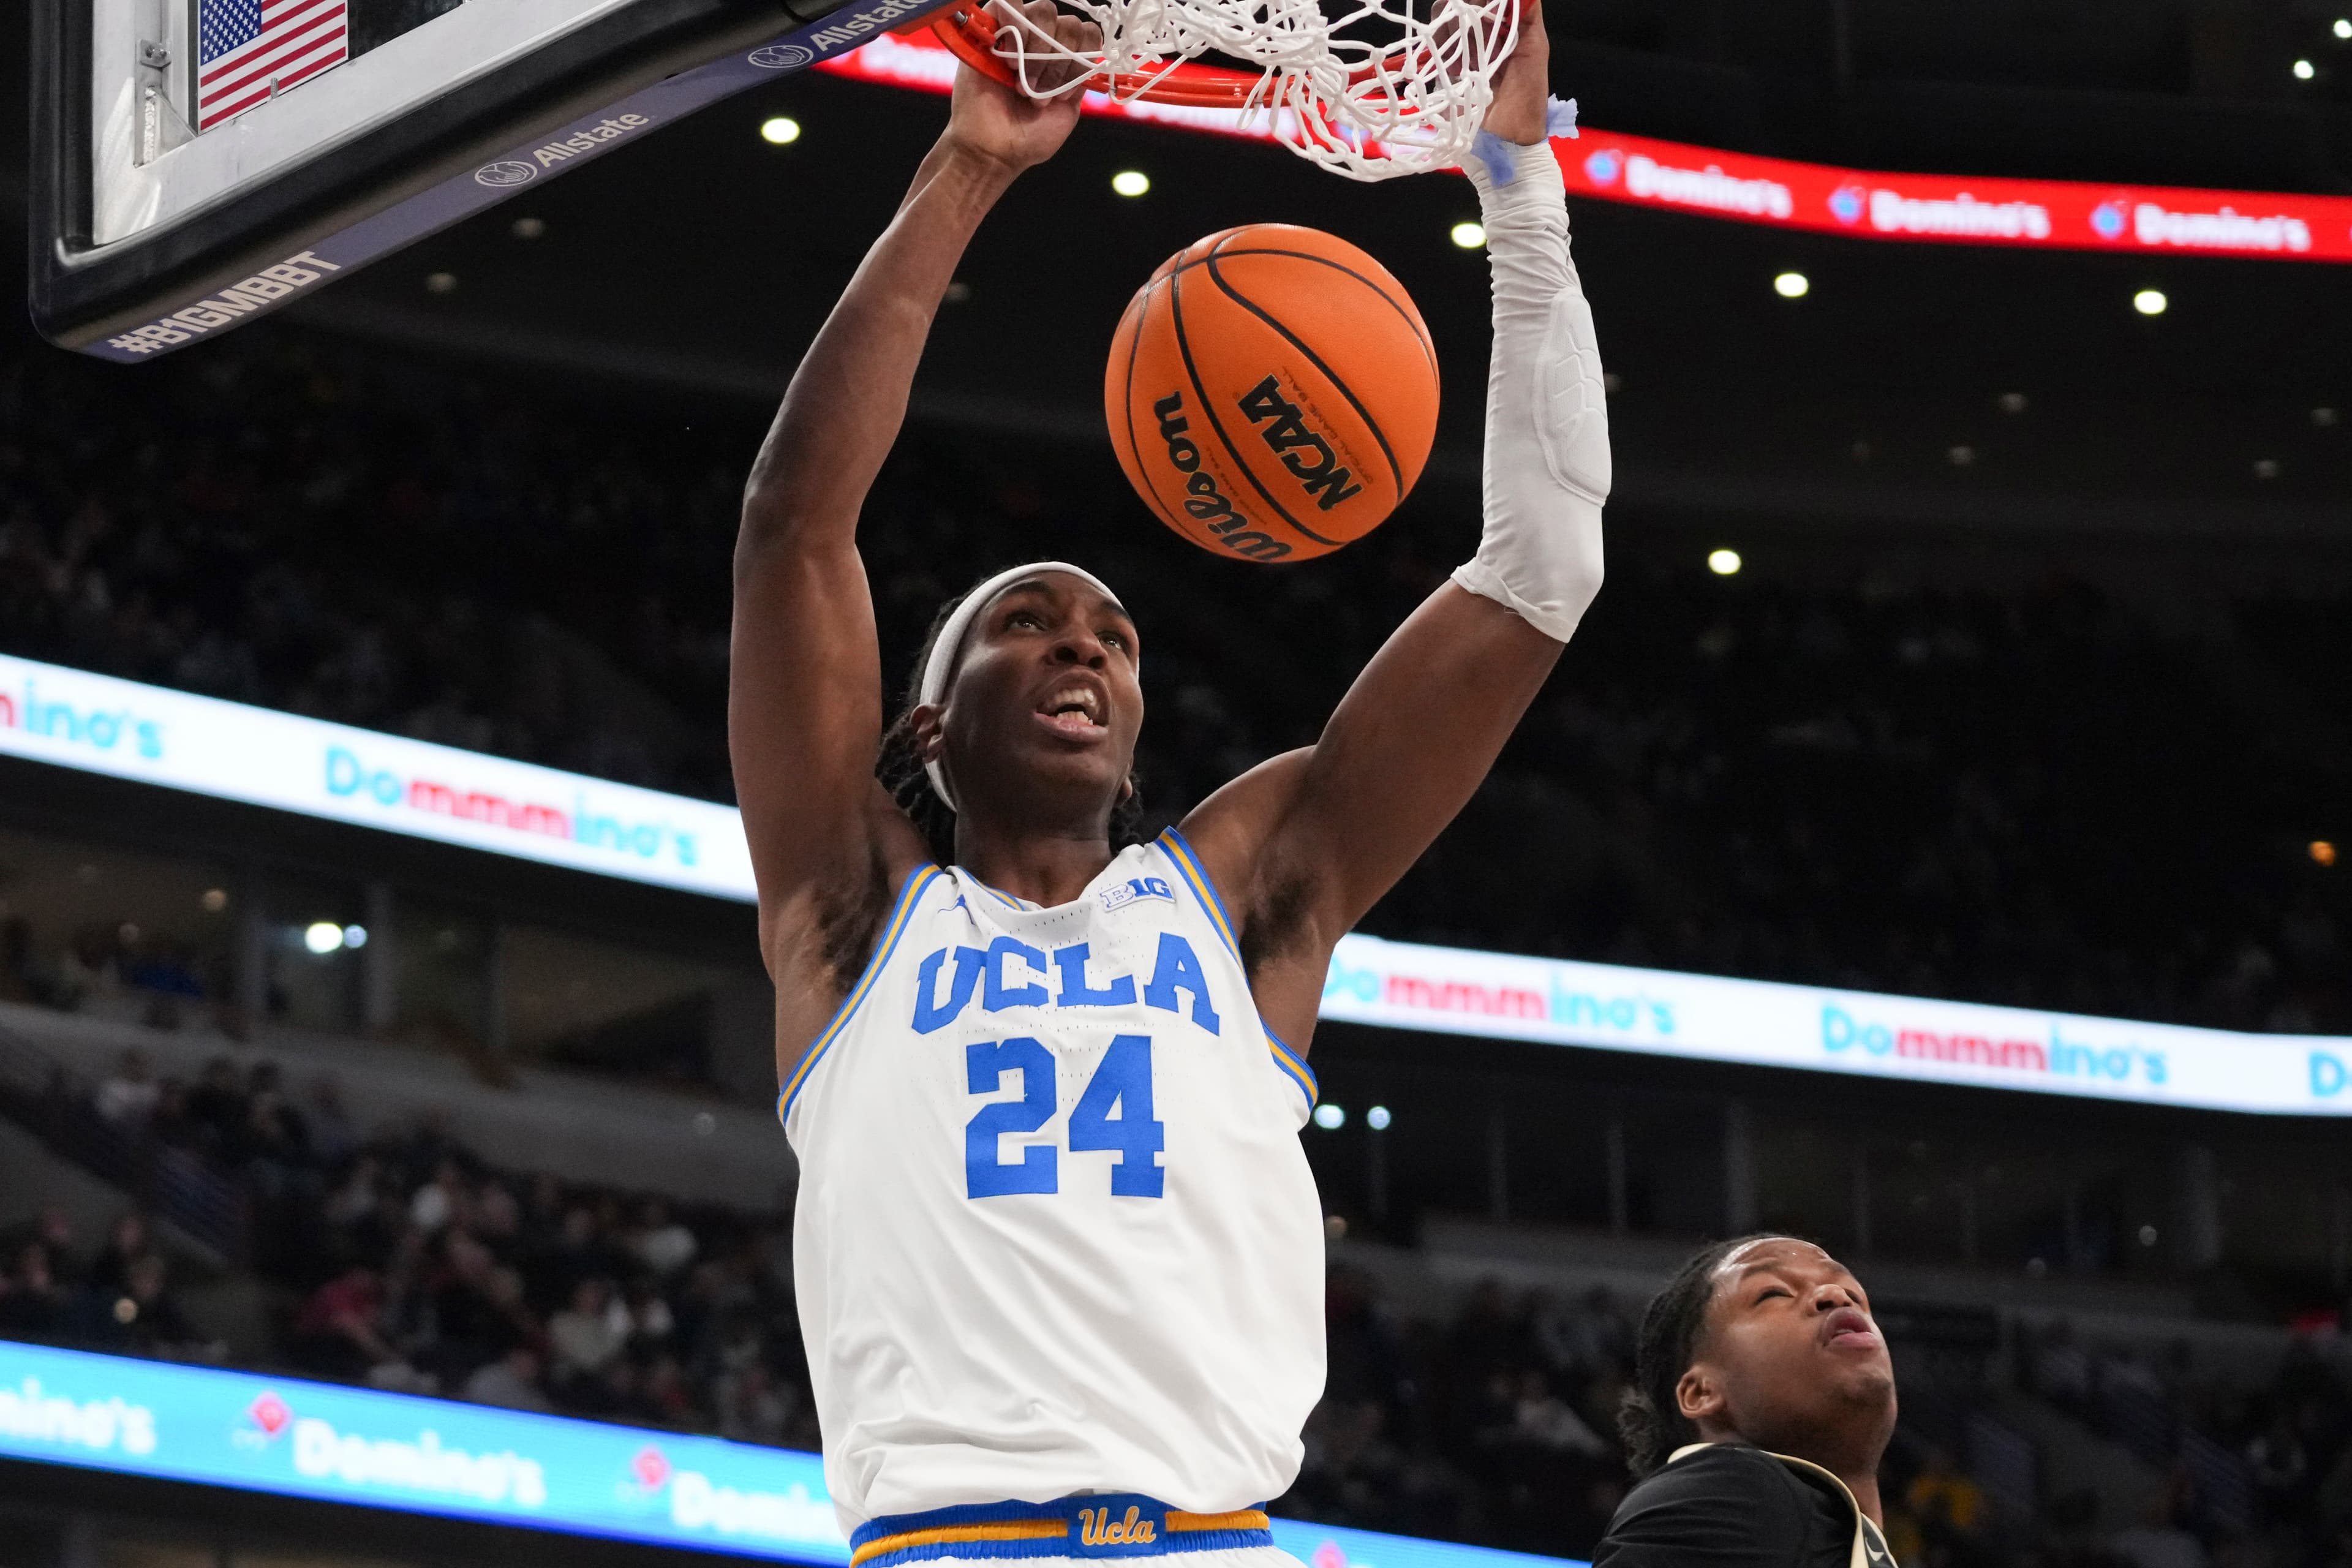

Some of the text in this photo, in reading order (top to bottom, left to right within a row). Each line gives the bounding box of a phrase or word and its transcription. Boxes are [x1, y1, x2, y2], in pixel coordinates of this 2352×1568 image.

[810, 0, 930, 52] Allstat
[533, 114, 650, 168] Allstate
[108, 250, 342, 353] #B1GMBBT
[1154, 391, 1293, 560] Wilson
[1238, 373, 1363, 511] NCAA
[325, 744, 698, 866] Dommmino's
[1099, 877, 1174, 908] B1G
[911, 932, 1220, 1036] UCLA
[1820, 1001, 2168, 1085] Dommmino's
[2308, 1049, 2352, 1098] D
[966, 1035, 1164, 1199] 24
[294, 1417, 546, 1507] Domino's
[671, 1471, 853, 1542] Domin
[1078, 1506, 1156, 1545] Ucla
